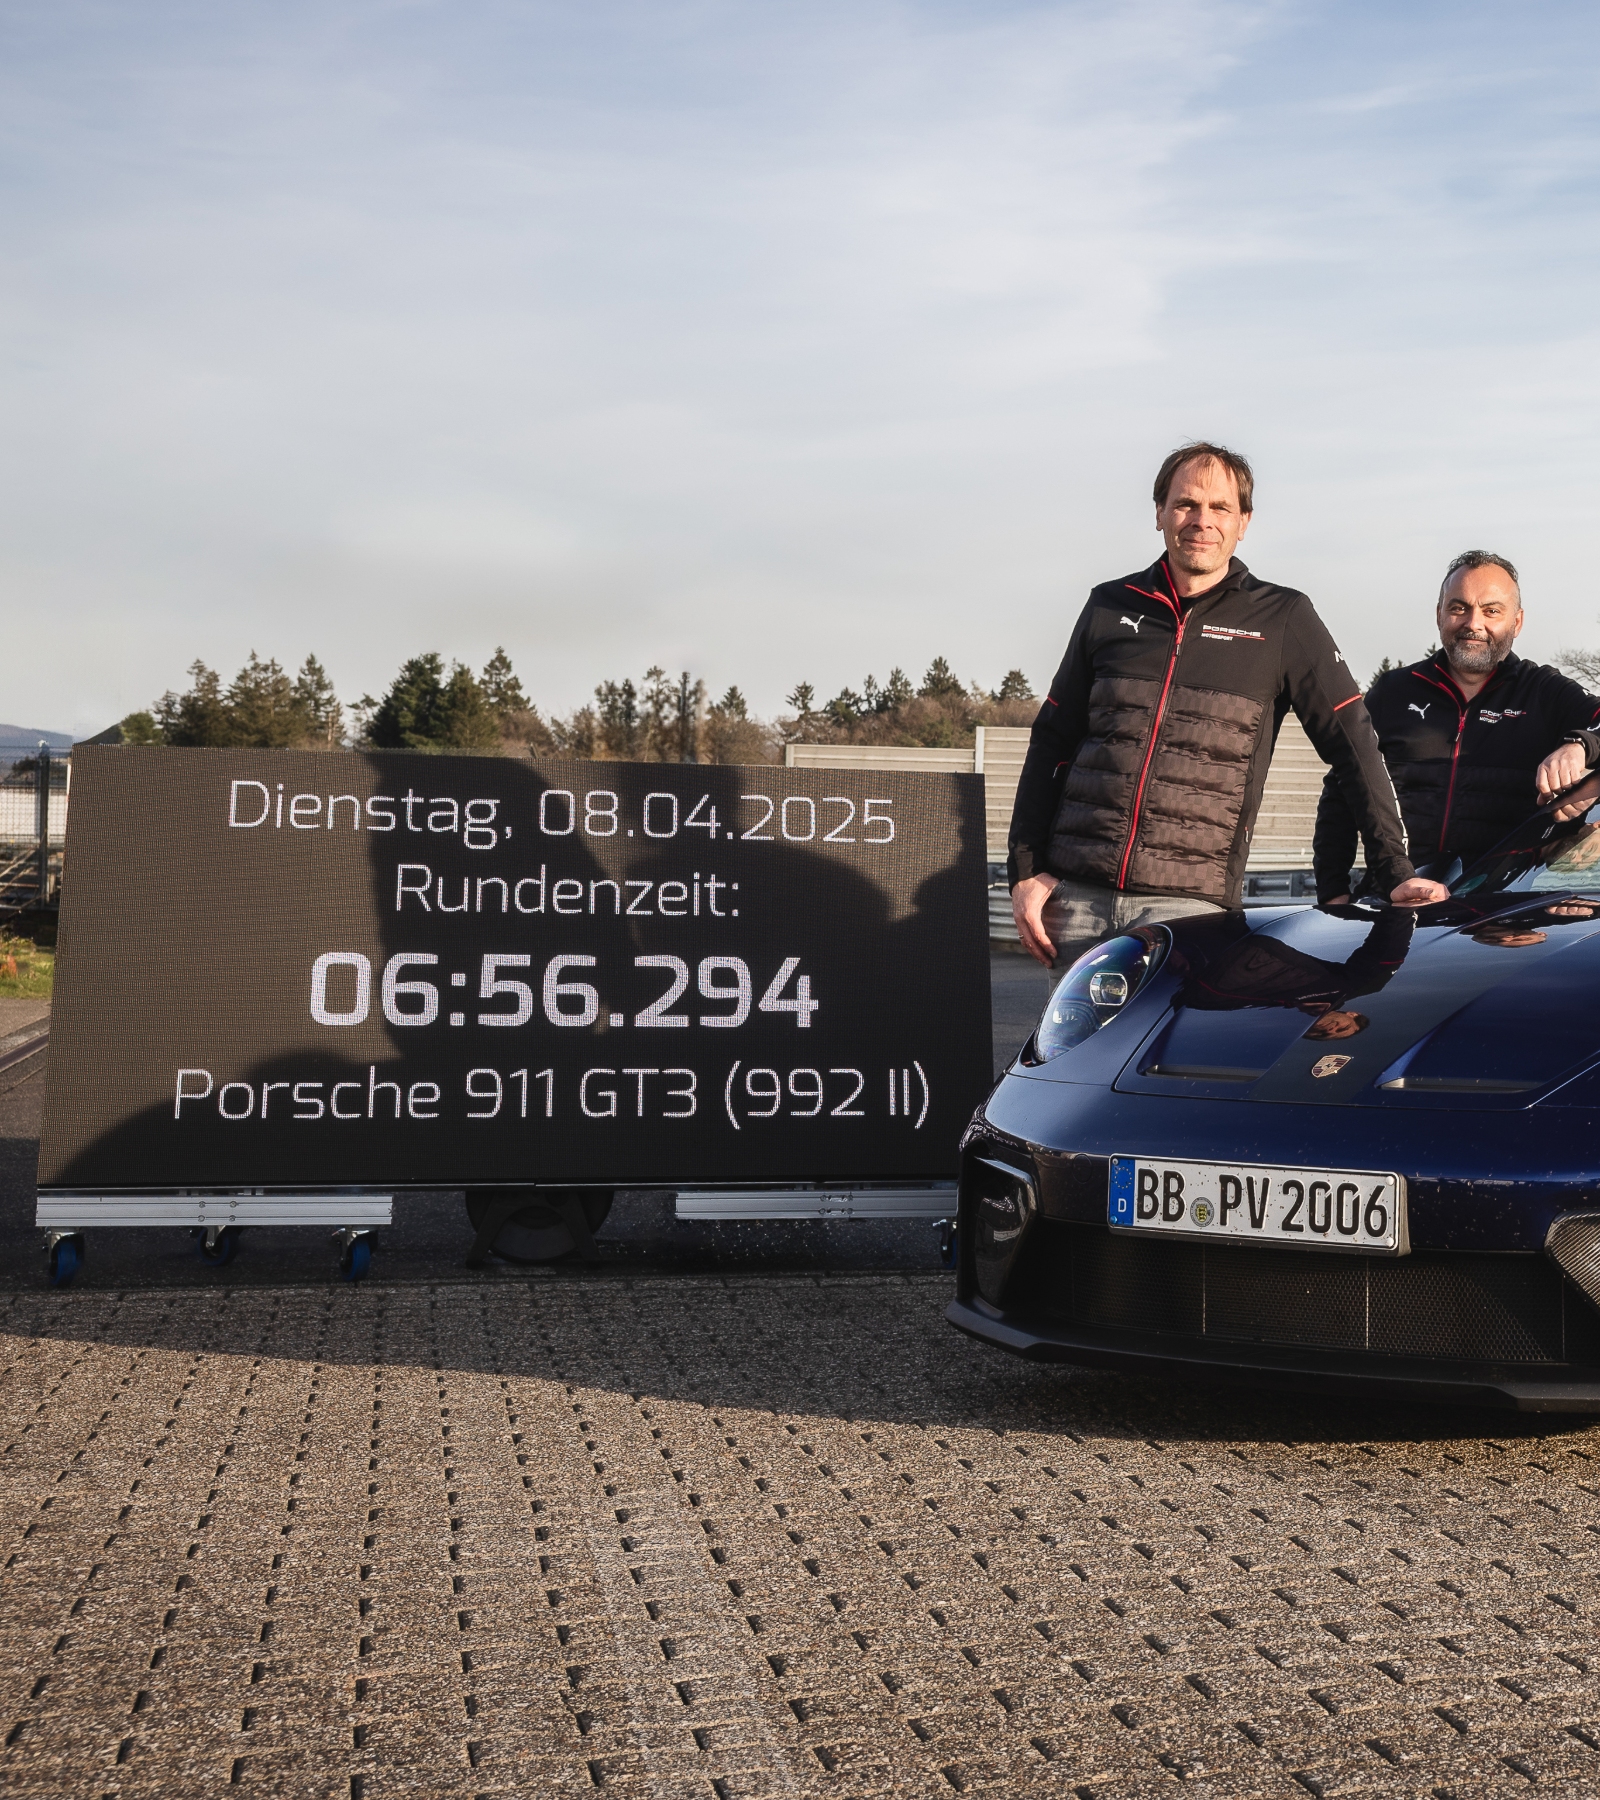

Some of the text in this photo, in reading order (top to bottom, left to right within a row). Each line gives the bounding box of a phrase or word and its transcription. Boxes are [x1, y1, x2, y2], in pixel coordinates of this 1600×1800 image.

[1202, 624, 1261, 638] PORSCHE
[229, 779, 896, 850] Dienstag, 08.04.2025
[396, 863, 740, 917] Rundenzeit:
[309, 951, 820, 1028] 06:56.294
[173, 1061, 930, 1130] Porsche 911 GT3 (992 II)
[1117, 1199, 1127, 1213] D
[1137, 1168, 1186, 1222] BB
[1219, 1174, 1270, 1229] PV
[1281, 1179, 1388, 1238] 2006
